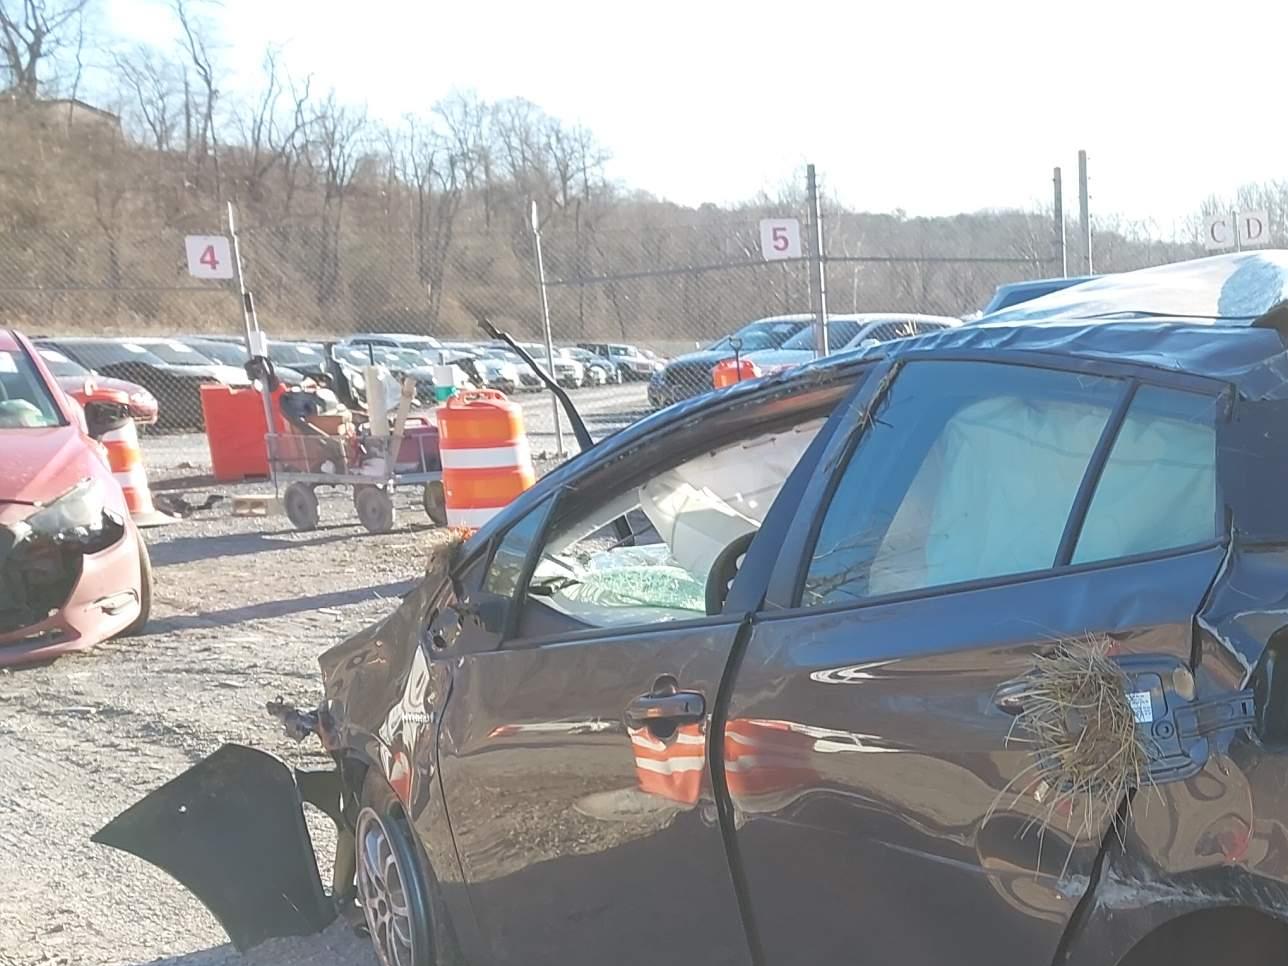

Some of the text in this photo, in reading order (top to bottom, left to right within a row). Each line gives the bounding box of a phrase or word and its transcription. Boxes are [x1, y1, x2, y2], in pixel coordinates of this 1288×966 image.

[772, 227, 789, 251] 5
[1210, 220, 1226, 243] C
[1246, 217, 1263, 240] D
[200, 245, 220, 270] 4
